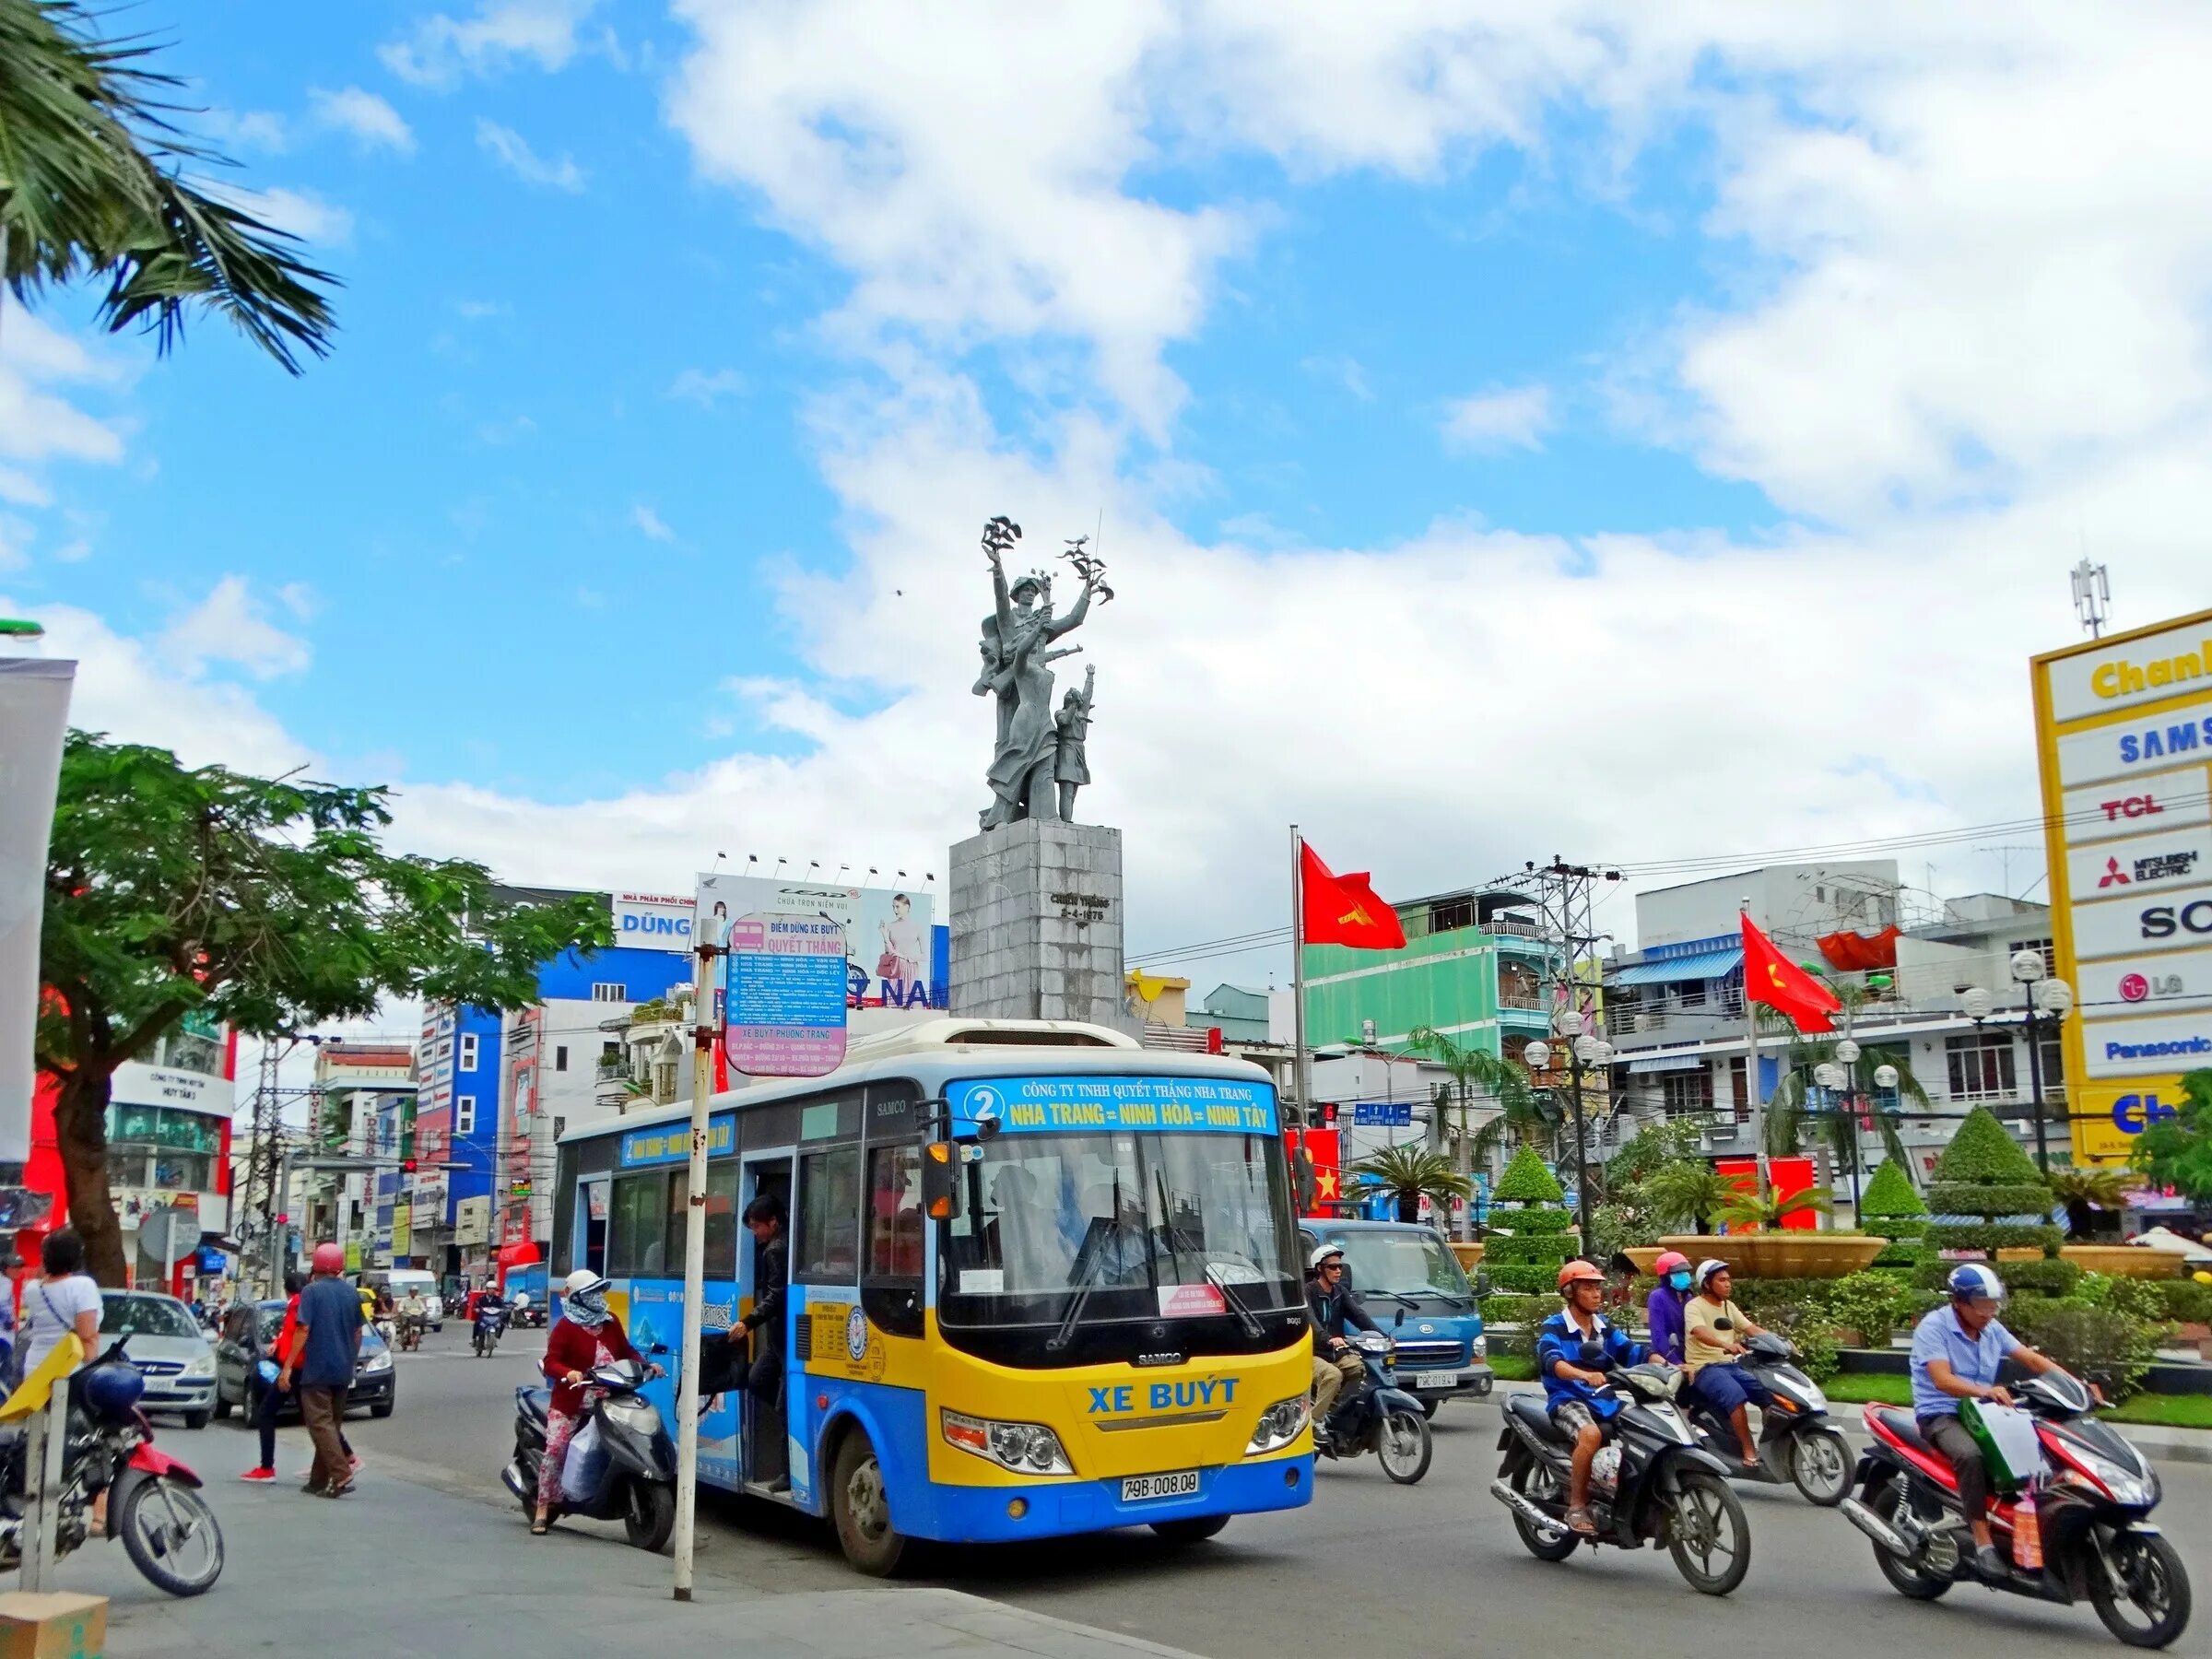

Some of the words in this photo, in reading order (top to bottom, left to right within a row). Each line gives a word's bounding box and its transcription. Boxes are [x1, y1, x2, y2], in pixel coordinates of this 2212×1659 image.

[2100, 794, 2164, 820] TCL
[2134, 851, 2198, 870] MITSUBISHI
[2136, 865, 2191, 882] ELECTRIC
[623, 912, 690, 935] DŨNG
[810, 924, 819, 935] XE
[768, 935, 801, 954] QUYẾT
[2152, 973, 2183, 994] LG
[743, 1030, 751, 1038] XE
[807, 1030, 830, 1039] TRANG
[2106, 1036, 2212, 1060] Panasonic
[1022, 1080, 1057, 1098] CÔNG
[1060, 1084, 1075, 1098] TY
[1077, 1084, 1111, 1098] TNHH
[1113, 1080, 1151, 1100] QUYẾT
[1153, 1079, 1193, 1099] THẮNG
[1194, 1086, 1217, 1100] NHA
[1218, 1087, 1253, 1100] TRANG
[877, 1100, 906, 1118] SAMCO
[974, 1090, 995, 1122] 2
[1009, 1103, 1046, 1126] NHA
[1049, 1103, 1106, 1125] TRANG
[1119, 1103, 1157, 1125] NINH
[1160, 1099, 1194, 1125] HÒA
[1206, 1105, 1241, 1126] NINH
[1242, 1101, 1267, 1129] TÂY
[700, 1299, 733, 1328] anest
[1138, 1352, 1182, 1365] SAMCO
[1088, 1386, 1134, 1413] XE
[1150, 1374, 1240, 1409] BUÝT
[1124, 1473, 1196, 1500] 79B-008.09
